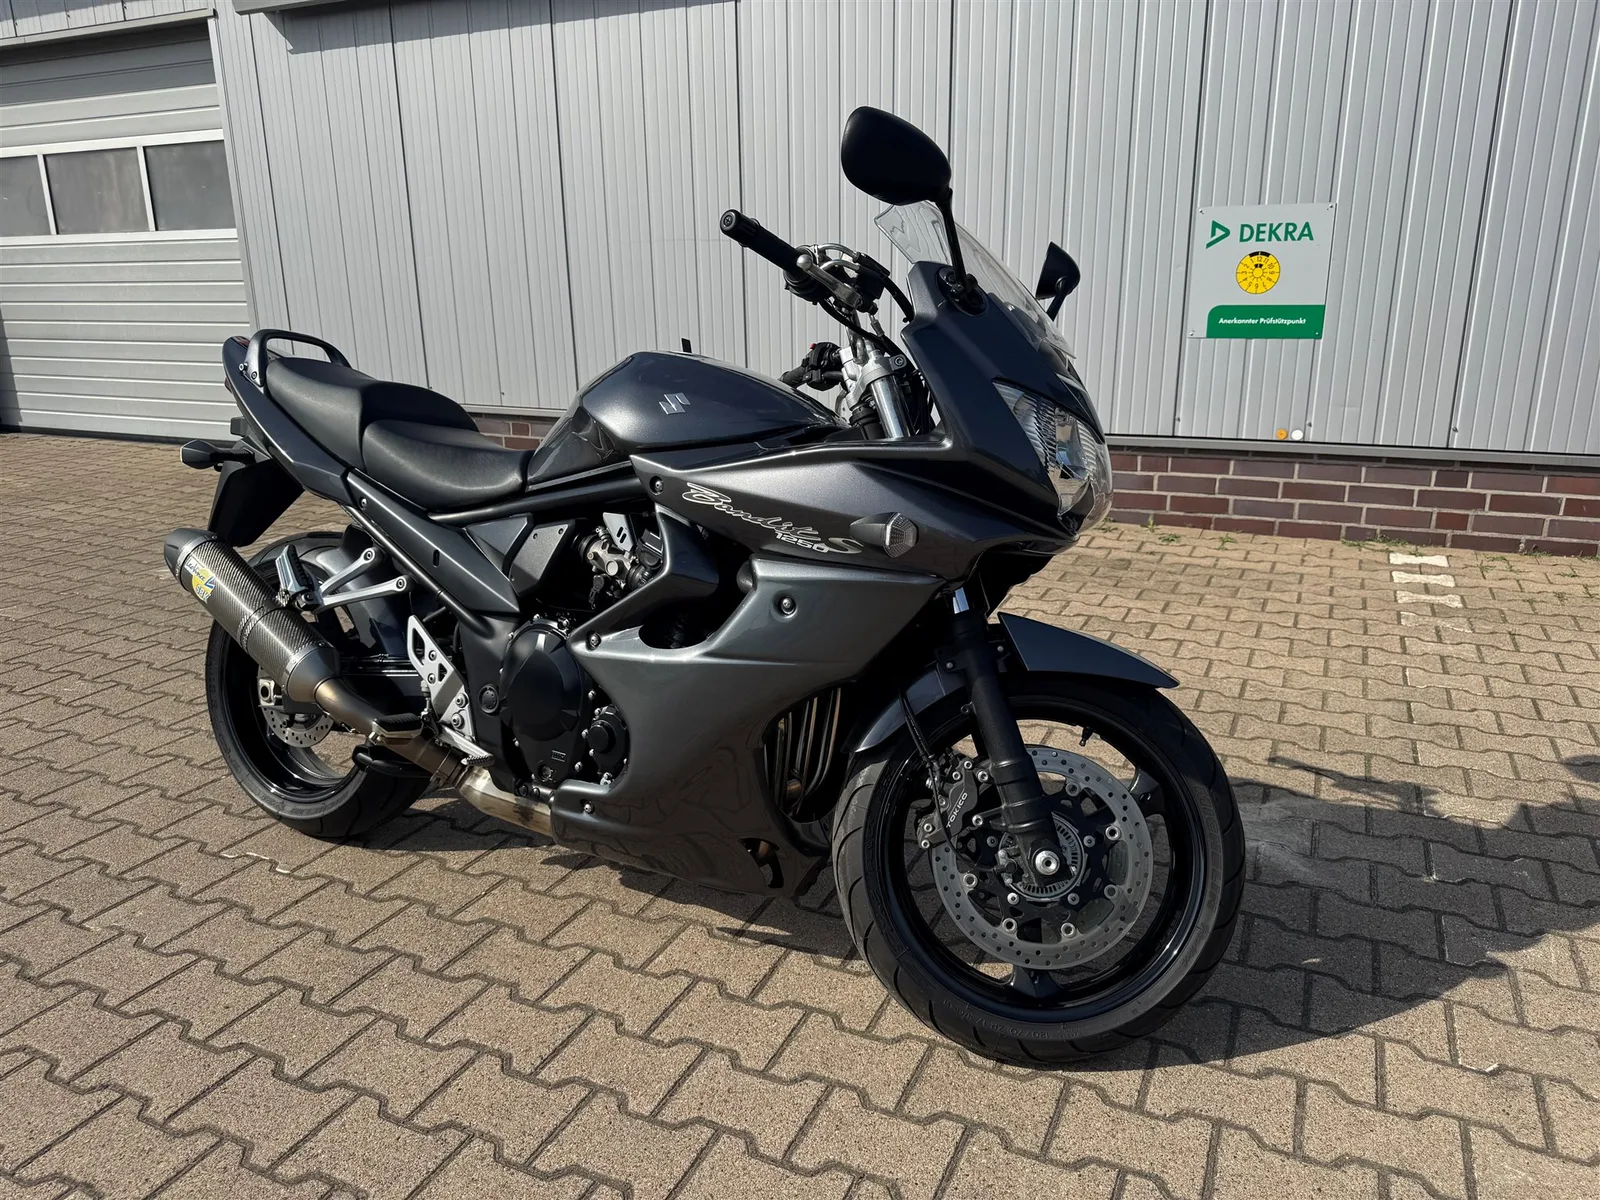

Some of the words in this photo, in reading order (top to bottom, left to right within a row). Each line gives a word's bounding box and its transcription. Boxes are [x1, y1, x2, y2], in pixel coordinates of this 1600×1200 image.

[1239, 222, 1314, 242] DEKRA
[1259, 317, 1306, 326] Prüfstützpunkt
[682, 482, 822, 541] Bandit
[775, 532, 829, 553] 1250
[824, 537, 864, 554] S
[946, 792, 968, 829] TOKICO
